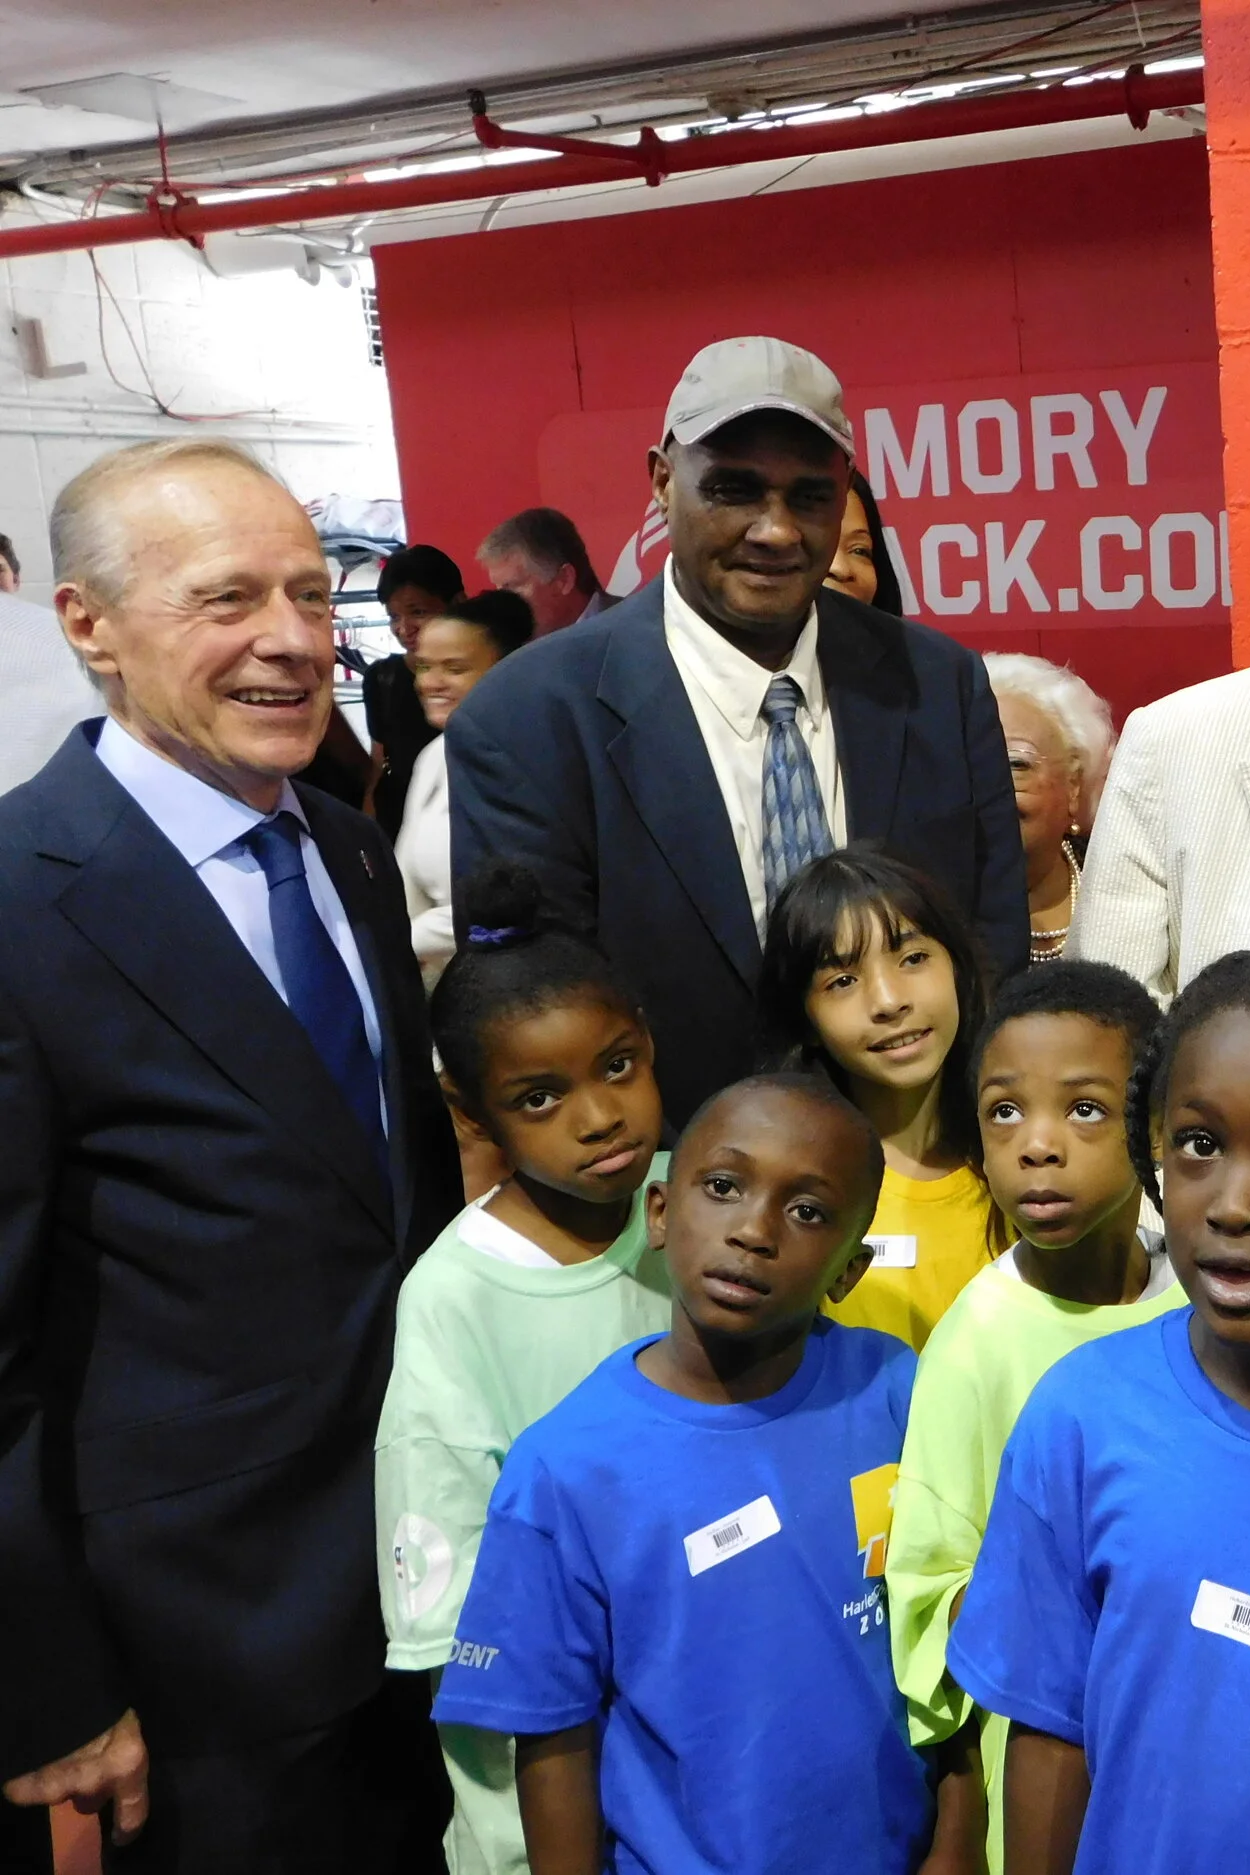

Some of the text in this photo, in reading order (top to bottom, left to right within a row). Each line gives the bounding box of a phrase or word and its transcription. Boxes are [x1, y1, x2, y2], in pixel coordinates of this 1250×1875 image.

[864, 386, 1168, 500] MORY
[881, 511, 1233, 616] ACK.CO
[843, 1592, 878, 1619] Harle
[448, 1638, 500, 1671] DENT
